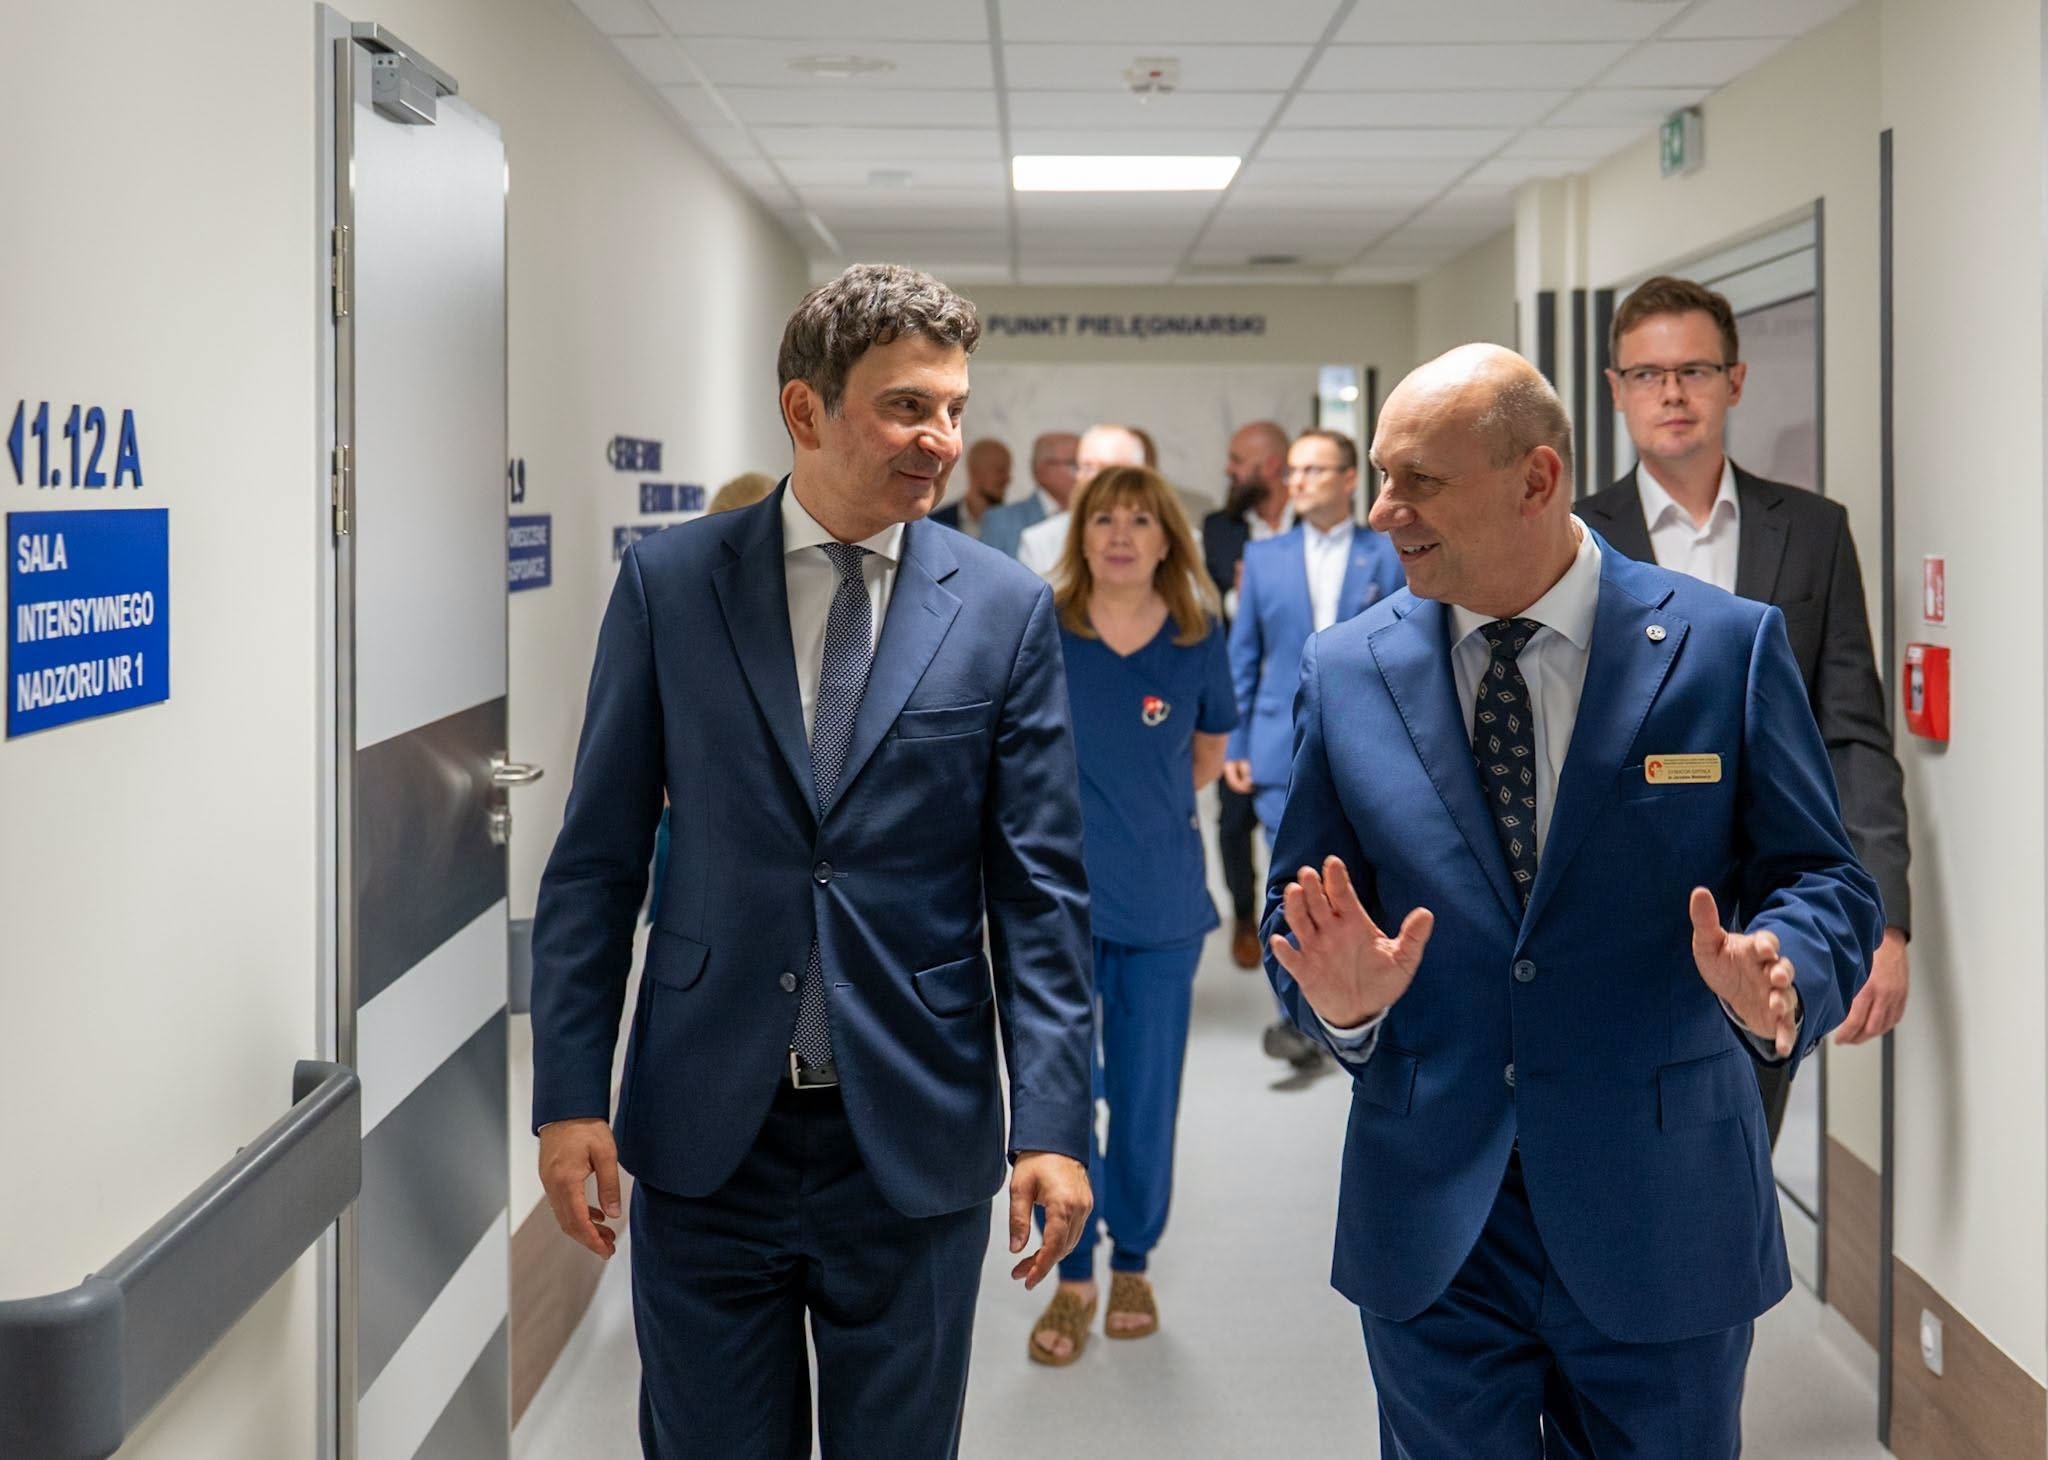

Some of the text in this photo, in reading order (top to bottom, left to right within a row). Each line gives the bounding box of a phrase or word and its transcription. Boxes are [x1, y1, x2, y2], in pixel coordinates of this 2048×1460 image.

[987, 314, 1267, 340] PUNKT PIELĘGNIARSKI
[17, 533, 68, 574] SALA
[16, 590, 155, 644] INTENSYWNEGO
[16, 652, 144, 712] NADZORU NR 1
